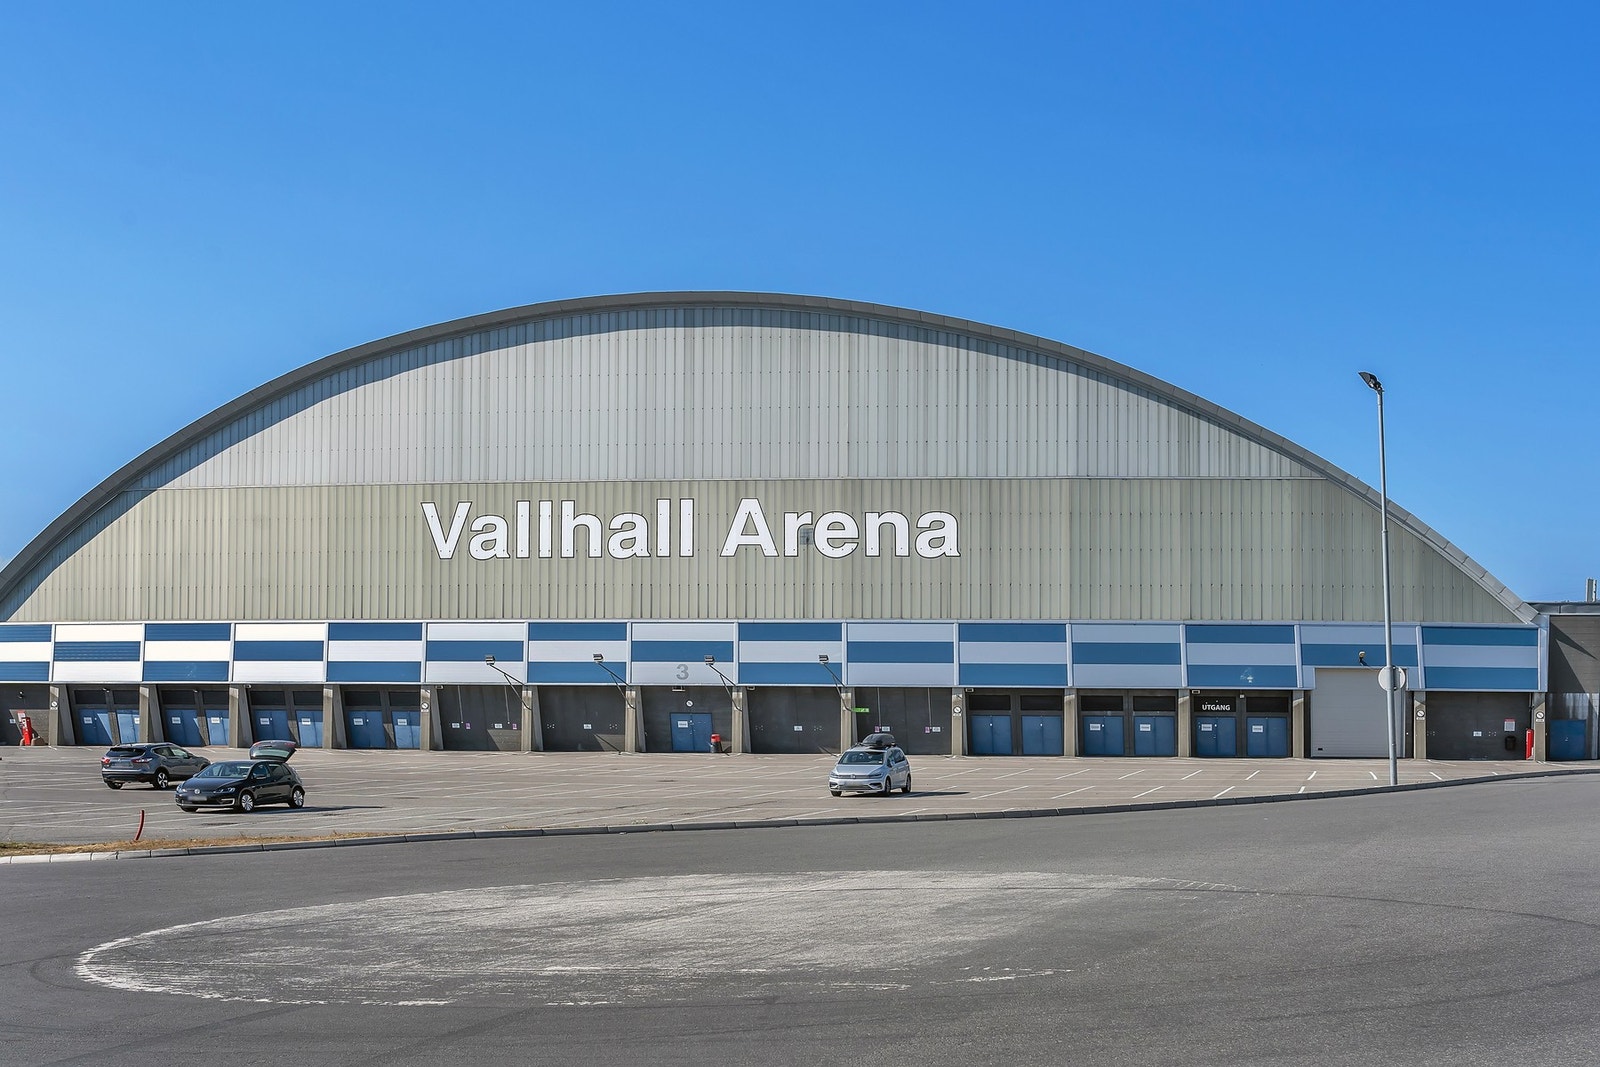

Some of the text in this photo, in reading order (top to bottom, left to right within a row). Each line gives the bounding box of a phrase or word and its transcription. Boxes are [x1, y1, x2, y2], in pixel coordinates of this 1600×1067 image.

[420, 498, 961, 560] Vallhall Arena
[676, 663, 689, 680] 3
